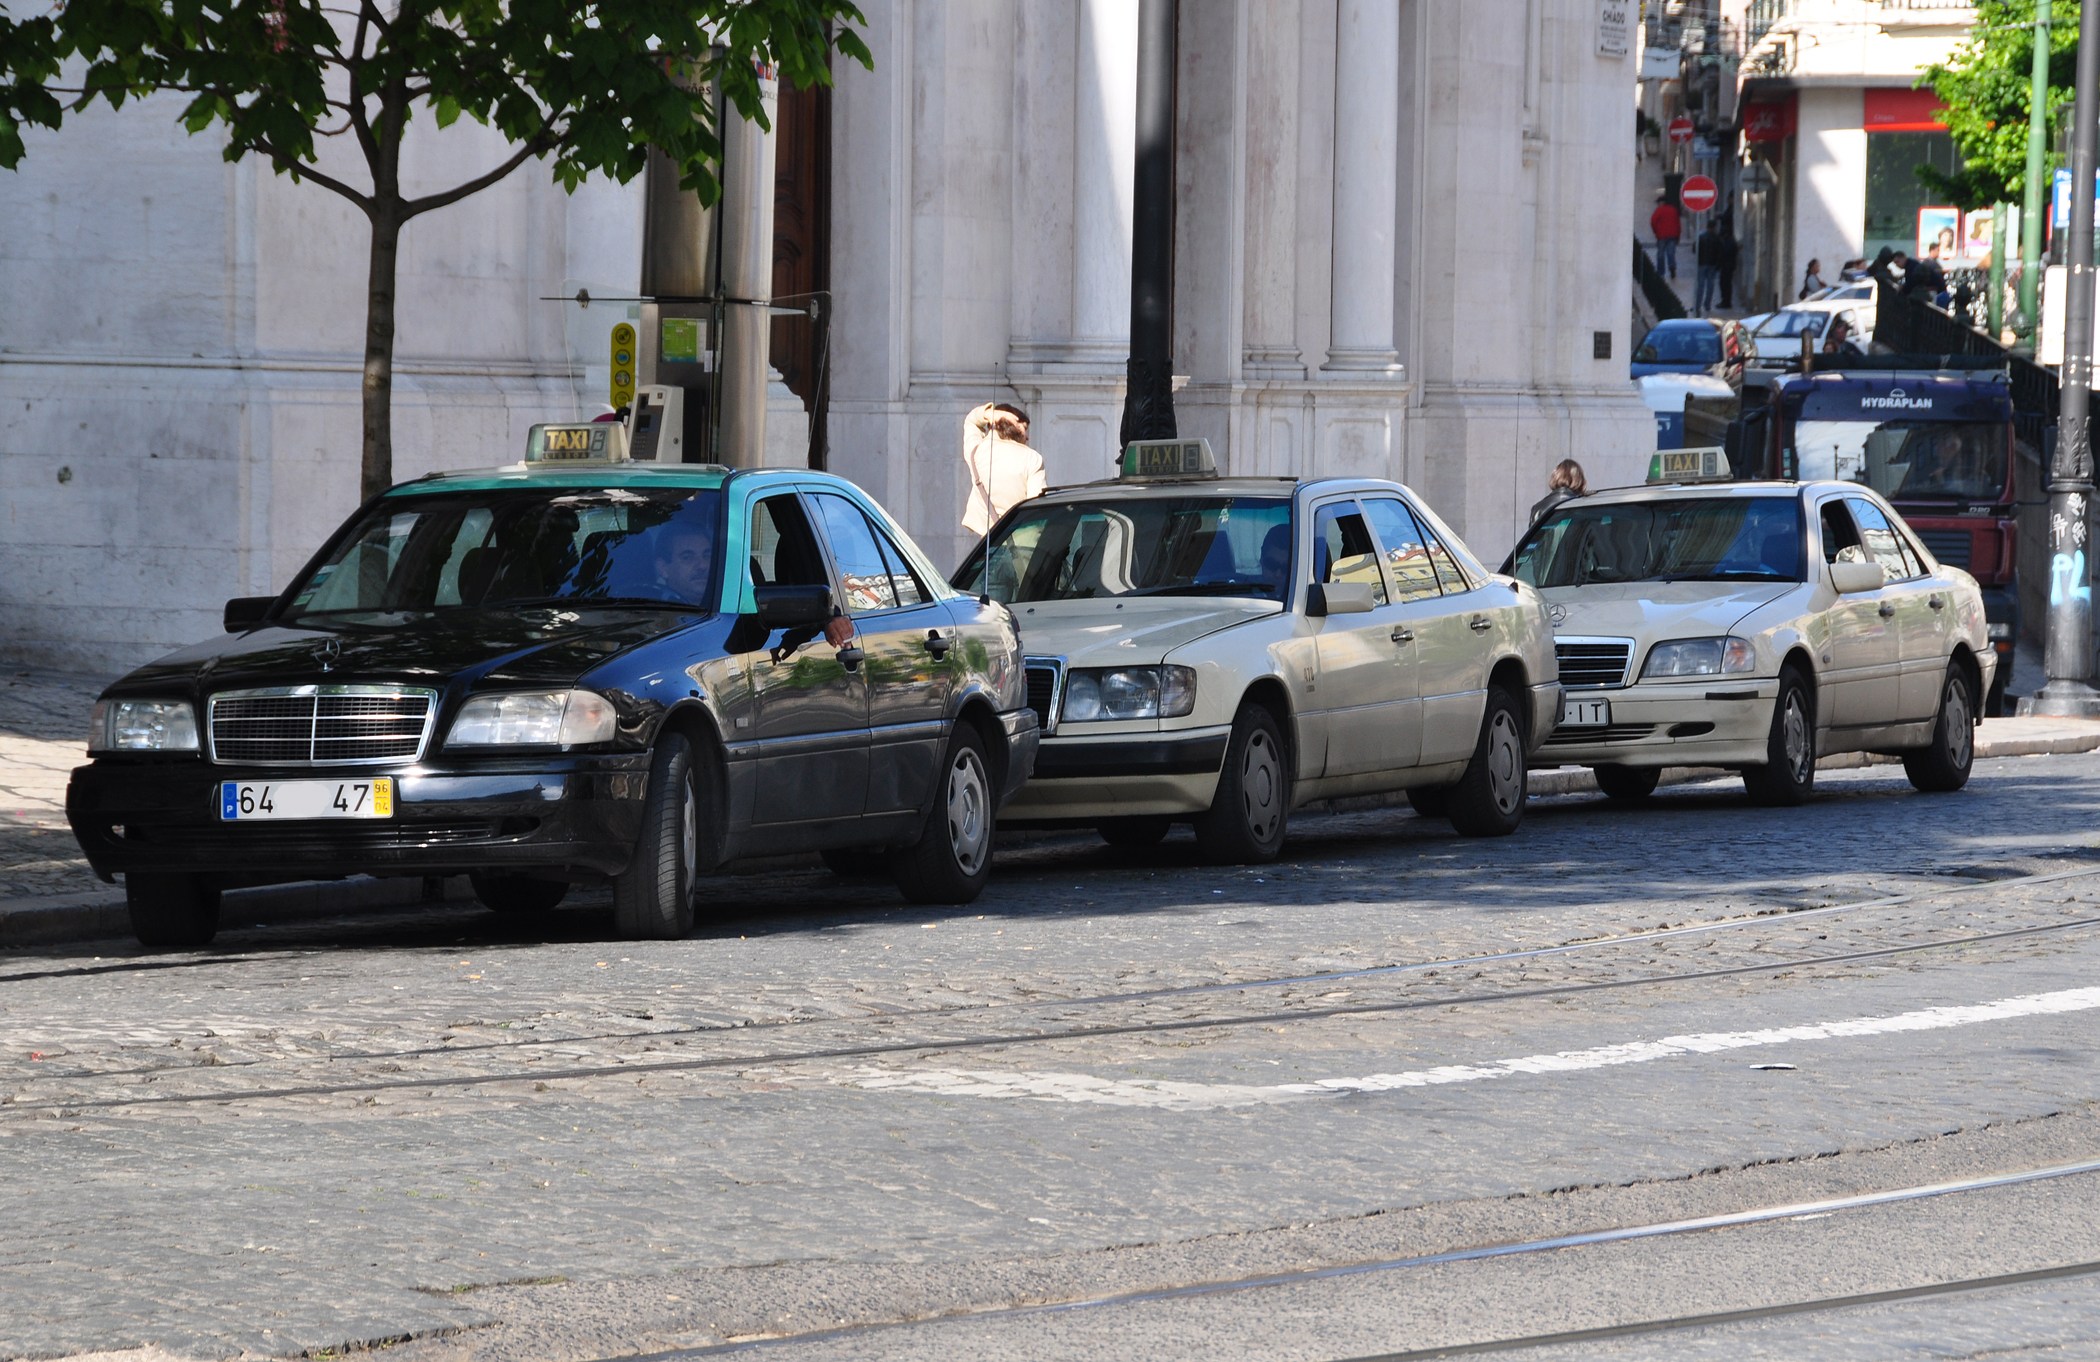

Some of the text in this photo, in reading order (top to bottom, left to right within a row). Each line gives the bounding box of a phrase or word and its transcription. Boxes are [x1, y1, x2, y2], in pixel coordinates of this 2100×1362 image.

[1861, 397, 1933, 408] HYDRAPLAN
[546, 430, 589, 450] TAXI
[1142, 446, 1179, 465] TAXI
[1665, 453, 1699, 471] TAXI
[374, 783, 388, 793] 96
[226, 784, 370, 814] P 64 47
[374, 801, 389, 812] 04
